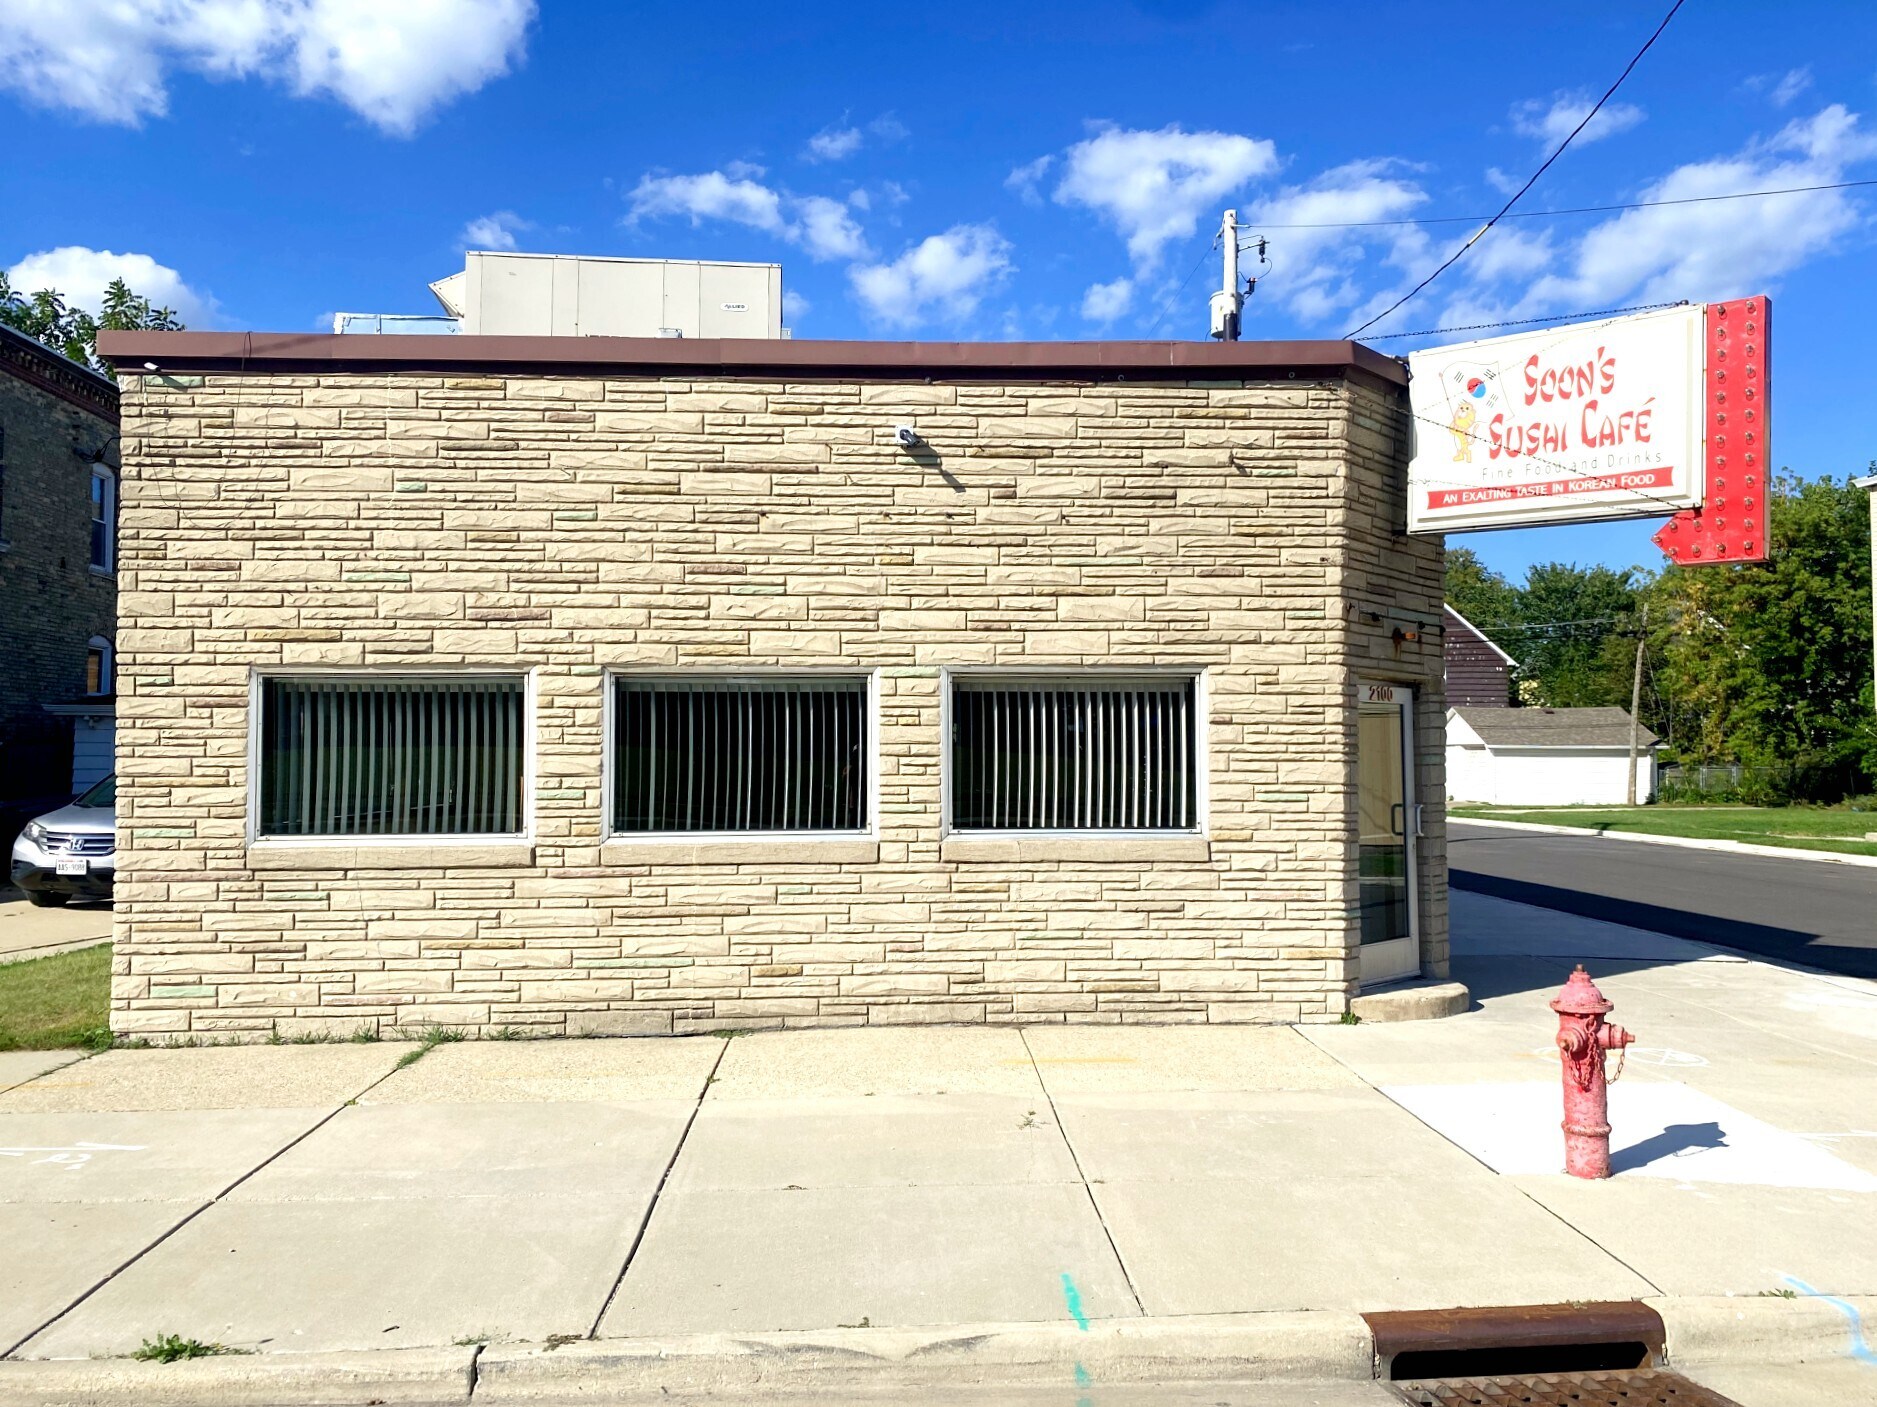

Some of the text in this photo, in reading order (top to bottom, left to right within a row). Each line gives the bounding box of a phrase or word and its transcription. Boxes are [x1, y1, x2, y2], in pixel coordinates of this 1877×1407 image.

[1524, 346, 1616, 406] SOON'S
[1489, 397, 1656, 460] SUSHI CAFÉ
[1482, 451, 1662, 481] Fine Food and Drinks
[1443, 474, 1655, 505] AN EXALTING TASTE IN KOREAN FOOD
[1369, 685, 1394, 702] 2100
